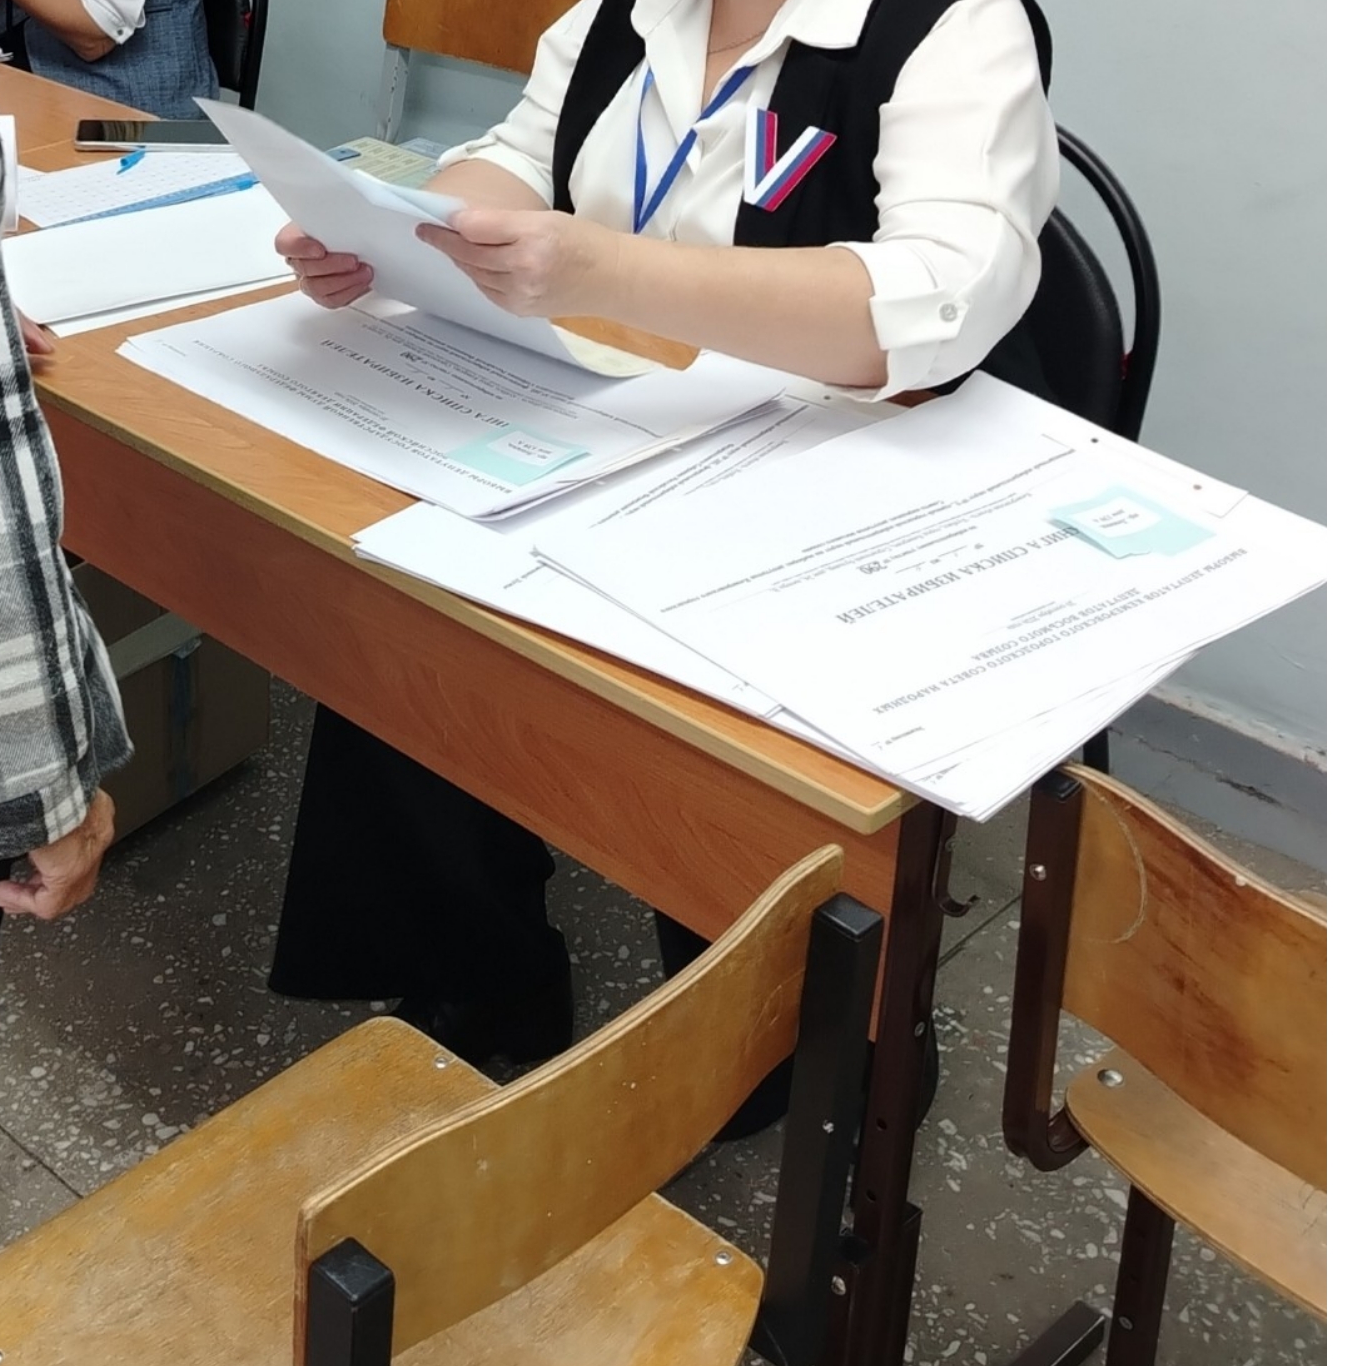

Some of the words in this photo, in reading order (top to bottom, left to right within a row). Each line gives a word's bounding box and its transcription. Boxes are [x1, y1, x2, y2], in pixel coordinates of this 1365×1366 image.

[858, 559, 884, 578] 290
[957, 541, 1028, 579] СПИСКА
[835, 568, 958, 627] ИЗБИРАТЕЛЕЙ
